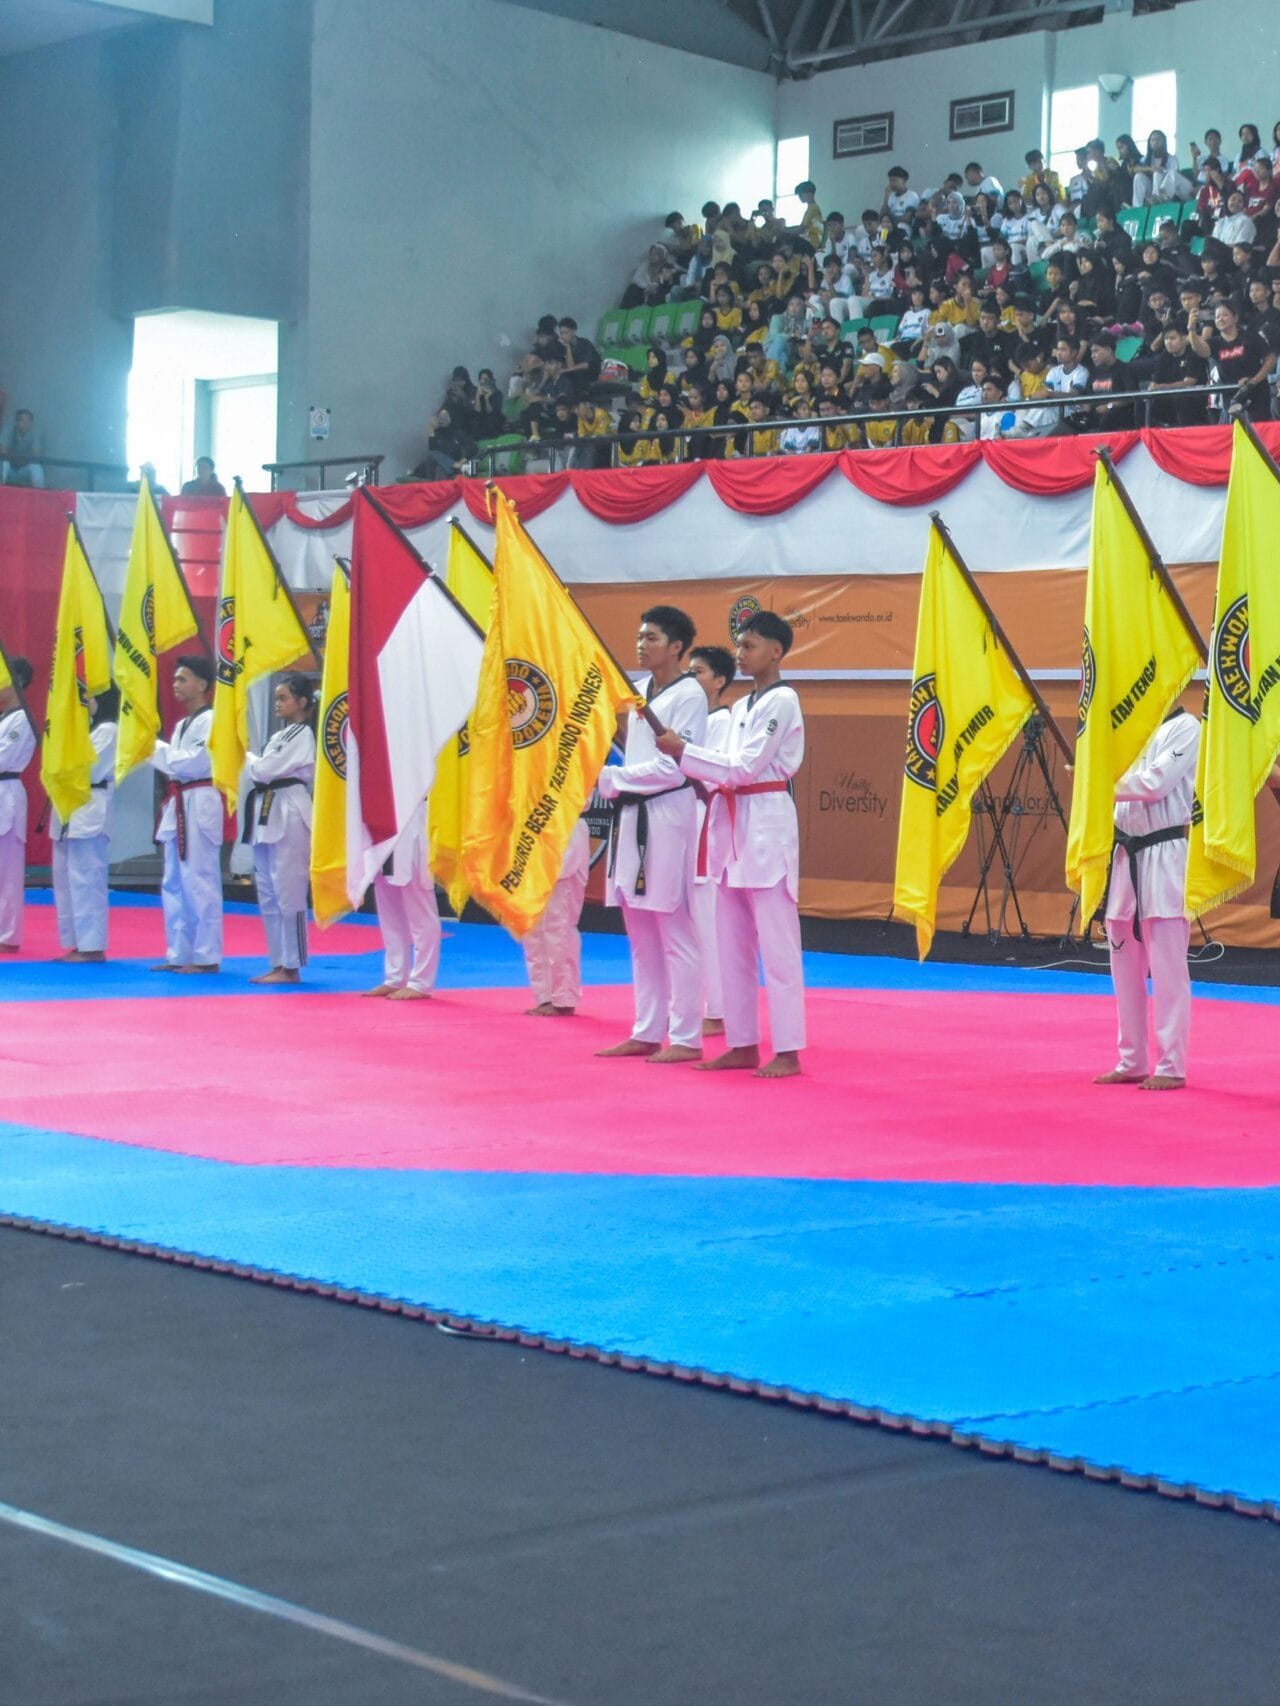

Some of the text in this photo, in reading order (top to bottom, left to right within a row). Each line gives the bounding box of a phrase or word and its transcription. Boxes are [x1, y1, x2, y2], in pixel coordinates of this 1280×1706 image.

[959, 704, 995, 746] TIMUR
[500, 662, 604, 894] PENGURUS BESAR TAEKWONDO INDONESI
[820, 790, 888, 819] Diversity
